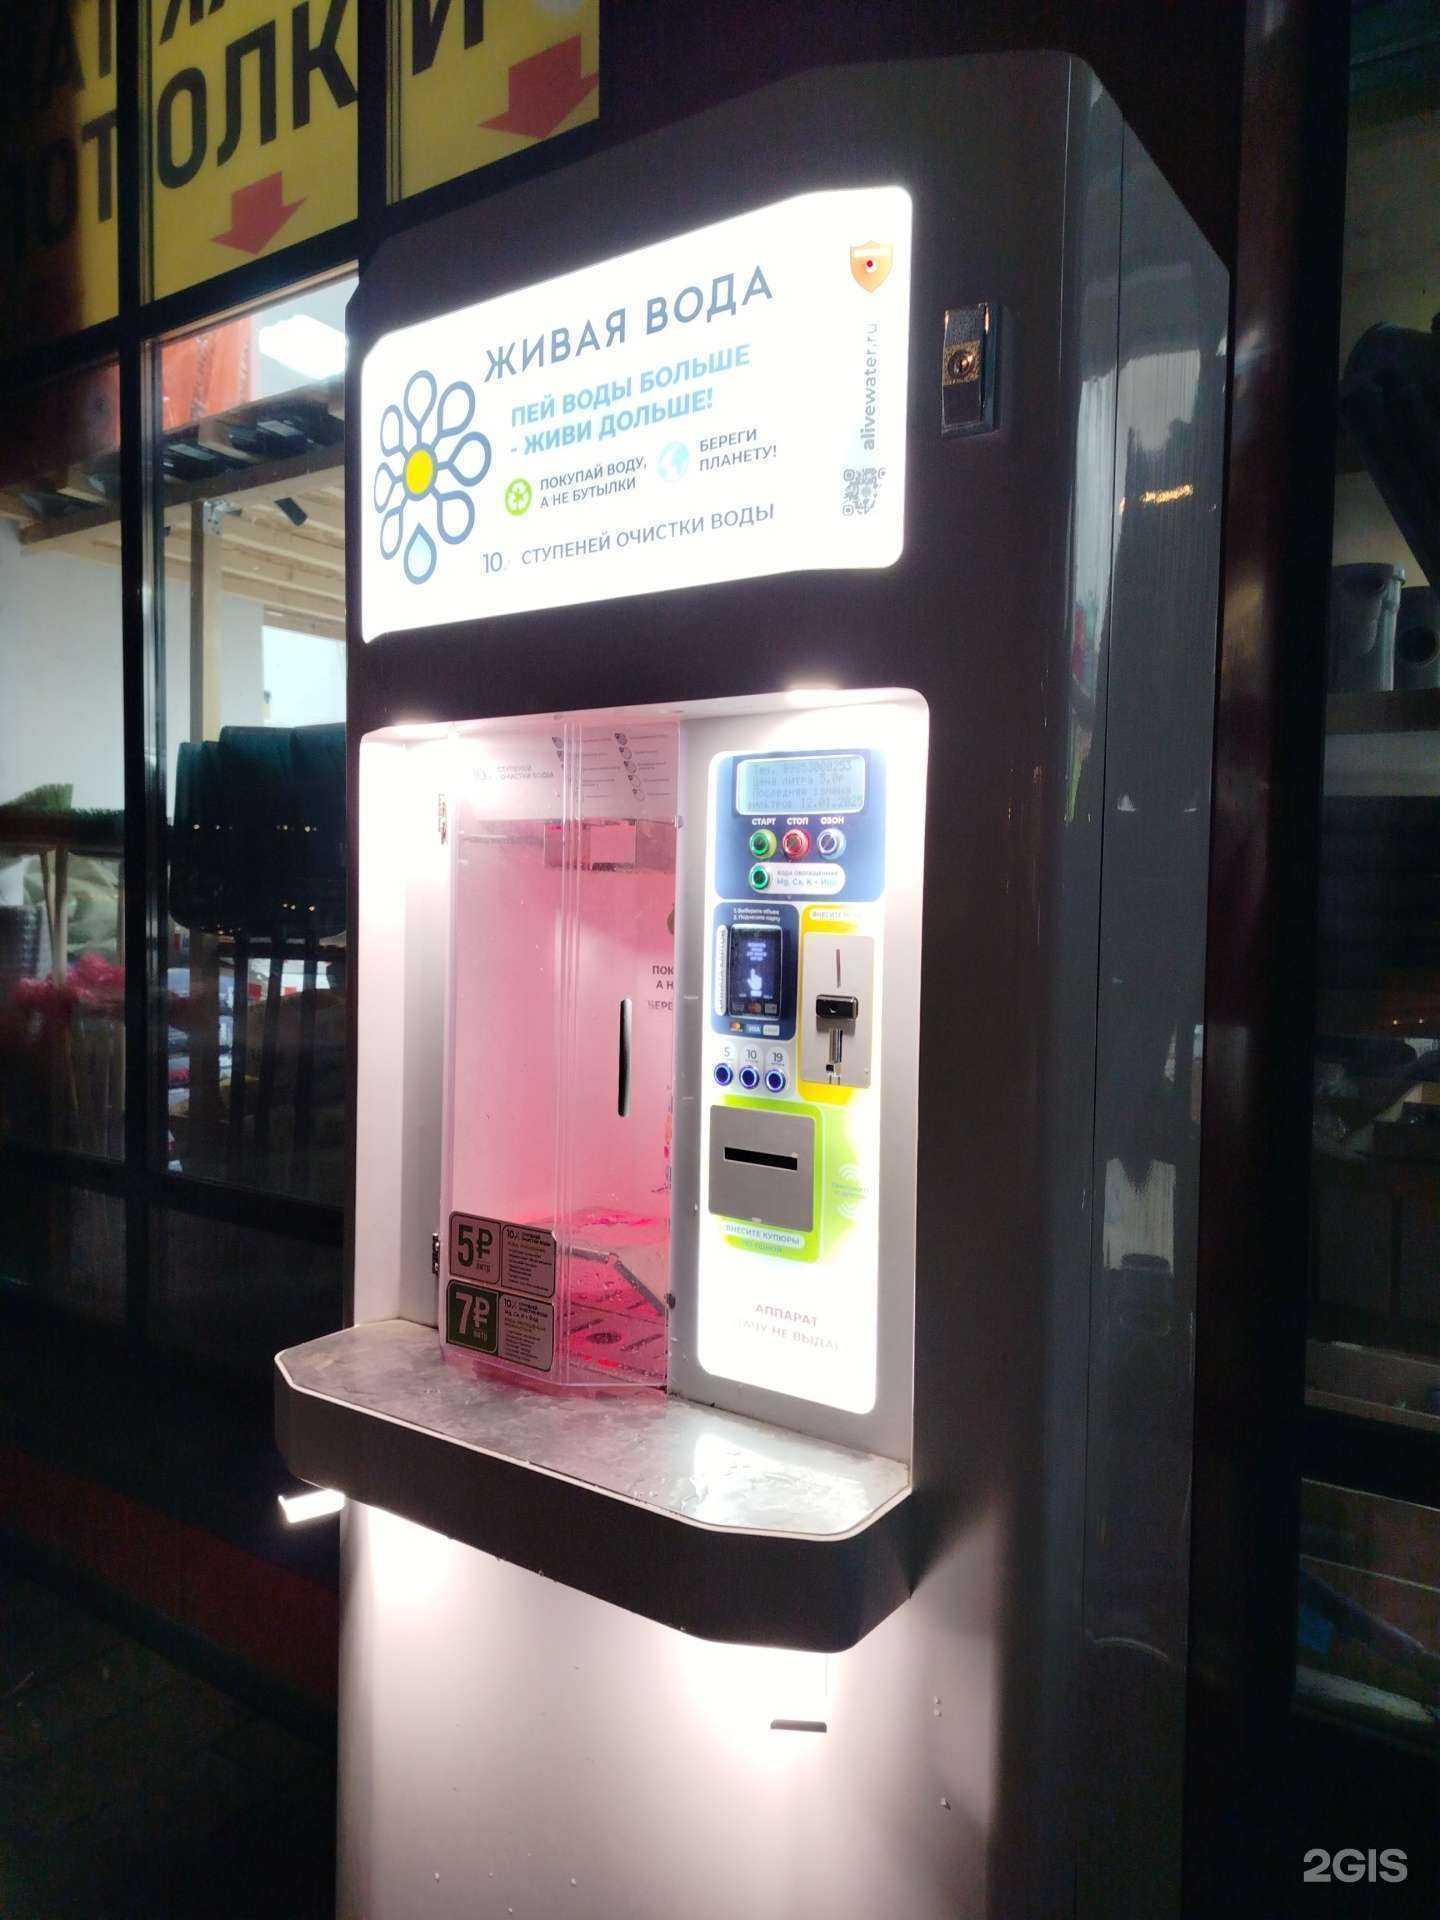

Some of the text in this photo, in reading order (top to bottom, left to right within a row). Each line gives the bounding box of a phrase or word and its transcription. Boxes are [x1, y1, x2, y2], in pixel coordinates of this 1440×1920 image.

[484, 265, 773, 382] ЖИВАЯ ВОДА
[511, 343, 752, 427] ПЕЙ ВОДЫ БОЛЬШЕ
[860, 322, 878, 451] alivewater.ru
[524, 419, 592, 456] ЖИВИ
[598, 387, 713, 440] ДОЛЬШЕ!
[699, 428, 757, 452] БЕРЕГИ
[540, 455, 647, 492] ПОКУПАЙ ВОДУ,
[699, 445, 778, 472] ПЛАНЕТУ!
[540, 477, 637, 509] А НЕ БУТЫЛКИ
[521, 532, 611, 566] СТУПЕНЕЙ
[616, 516, 705, 548] ОЧИСТКИ
[711, 503, 774, 531] ВОДЫ
[751, 816, 845, 826] СТАРТ СТОП ОЗОН
[723, 1046, 731, 1058] 5
[746, 1049, 758, 1060] 10
[772, 1051, 784, 1063] 19
[762, 1229, 800, 1245] КУПЮРЫ
[754, 1303, 818, 1329] АППАРАТ
